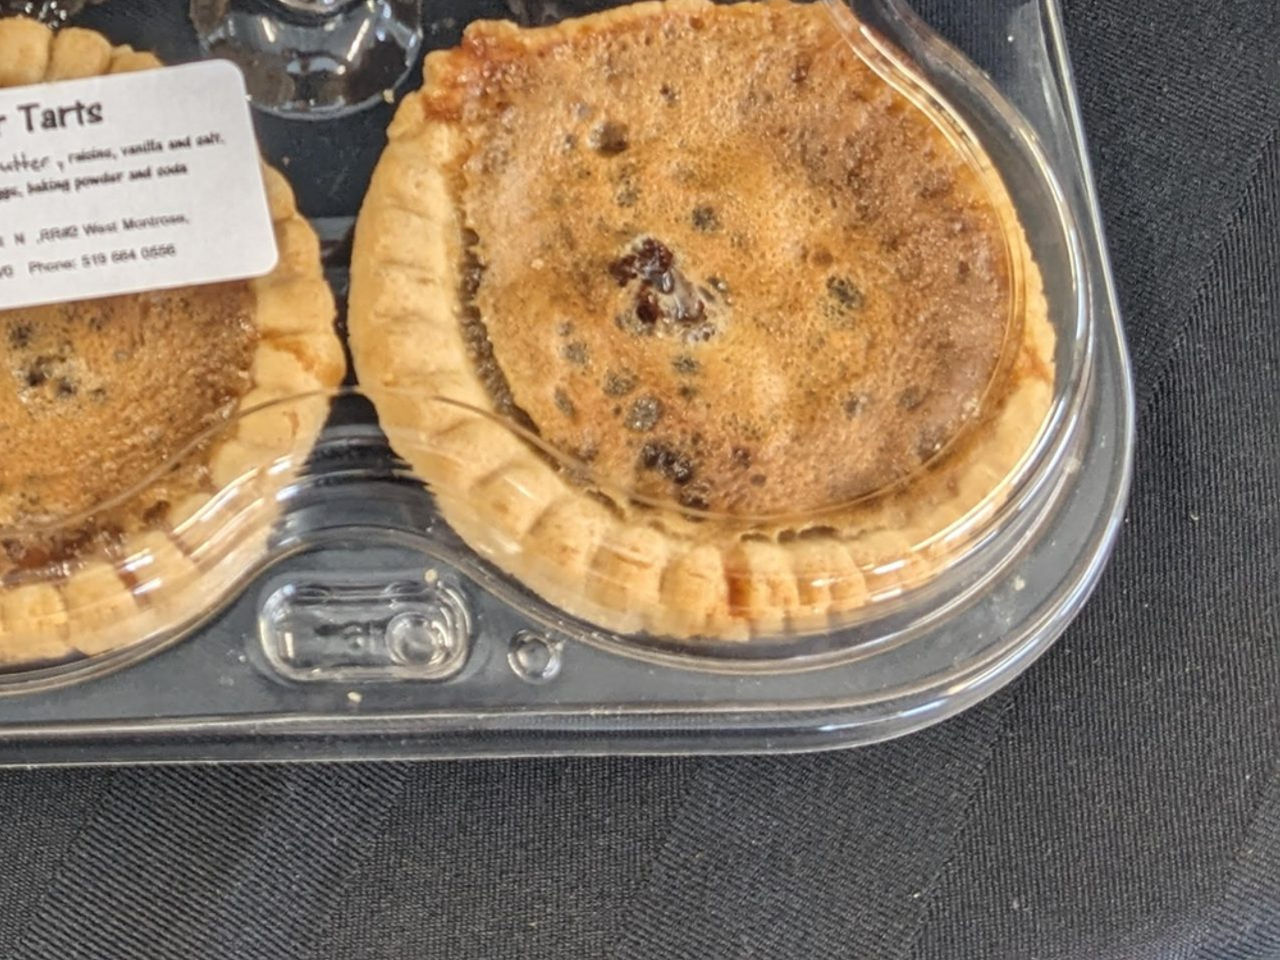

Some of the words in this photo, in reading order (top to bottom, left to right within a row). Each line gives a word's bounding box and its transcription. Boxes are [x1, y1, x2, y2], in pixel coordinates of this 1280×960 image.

[17, 100, 103, 132] Tarts
[68, 147, 117, 163] raisins,
[121, 139, 163, 156] vanilla
[168, 136, 191, 150] and
[26, 178, 70, 195] baking
[74, 171, 124, 190] powder
[128, 167, 152, 181] and
[157, 162, 188, 177] soda
[14, 232, 25, 244] N
[82, 221, 117, 237] West
[81, 252, 107, 267] 519
